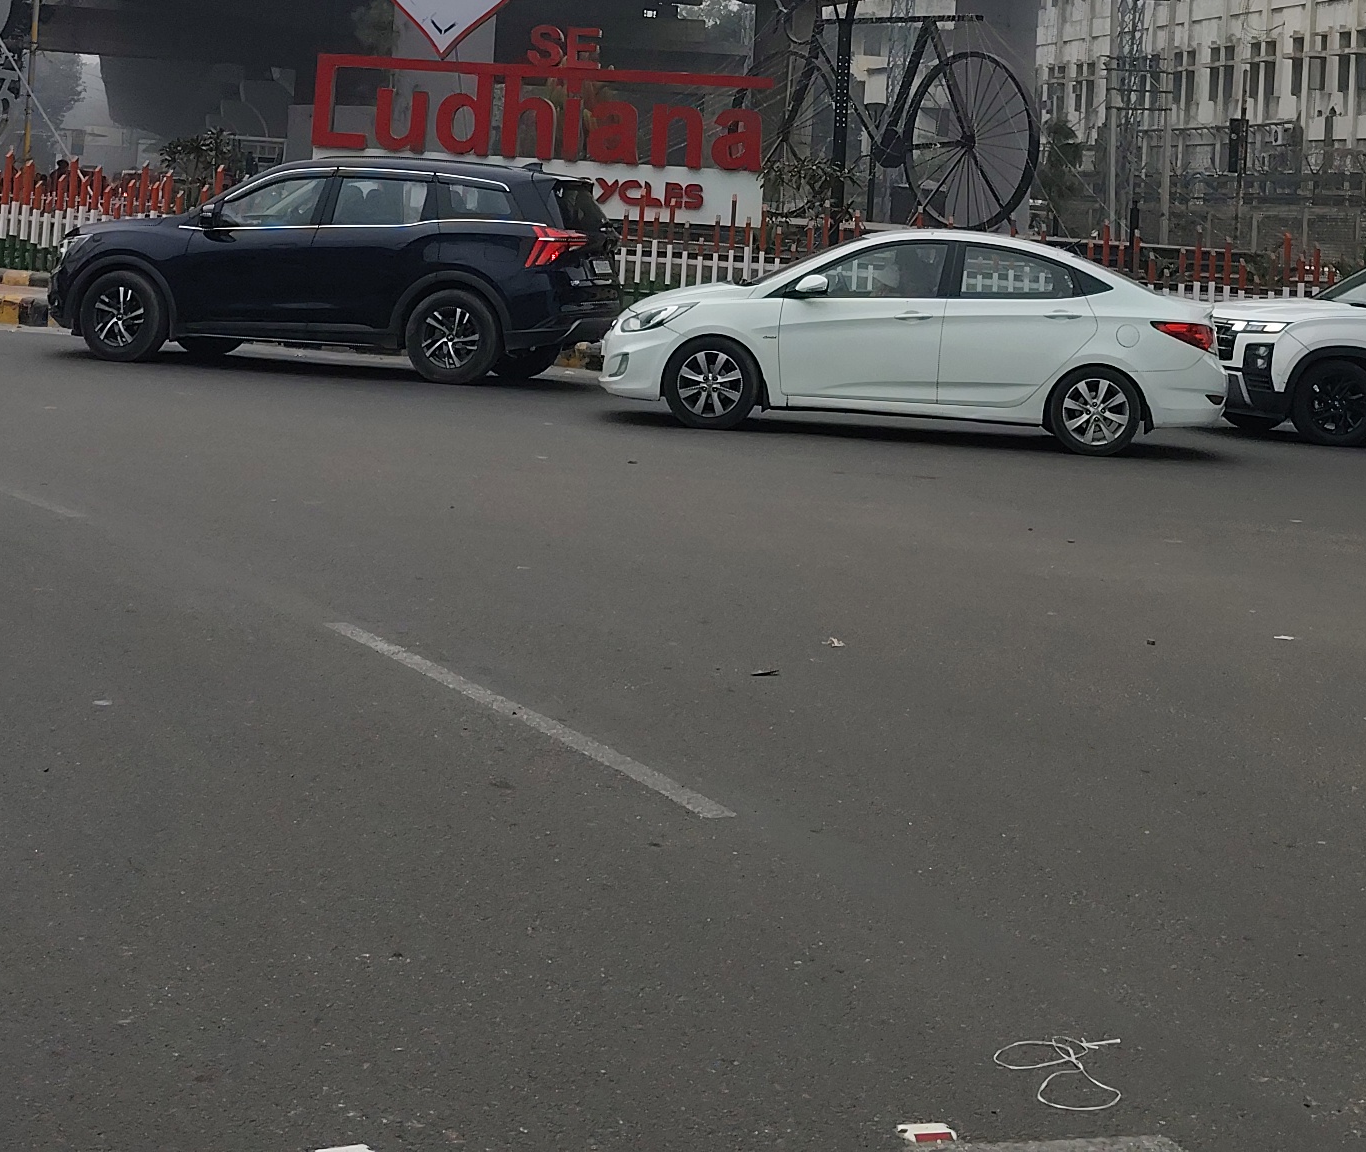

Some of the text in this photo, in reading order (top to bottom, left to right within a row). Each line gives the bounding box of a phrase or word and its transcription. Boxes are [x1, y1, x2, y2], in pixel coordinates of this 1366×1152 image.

[527, 25, 602, 70] SE
[310, 53, 775, 172] Ludhiana
[595, 176, 704, 210] YCLES
